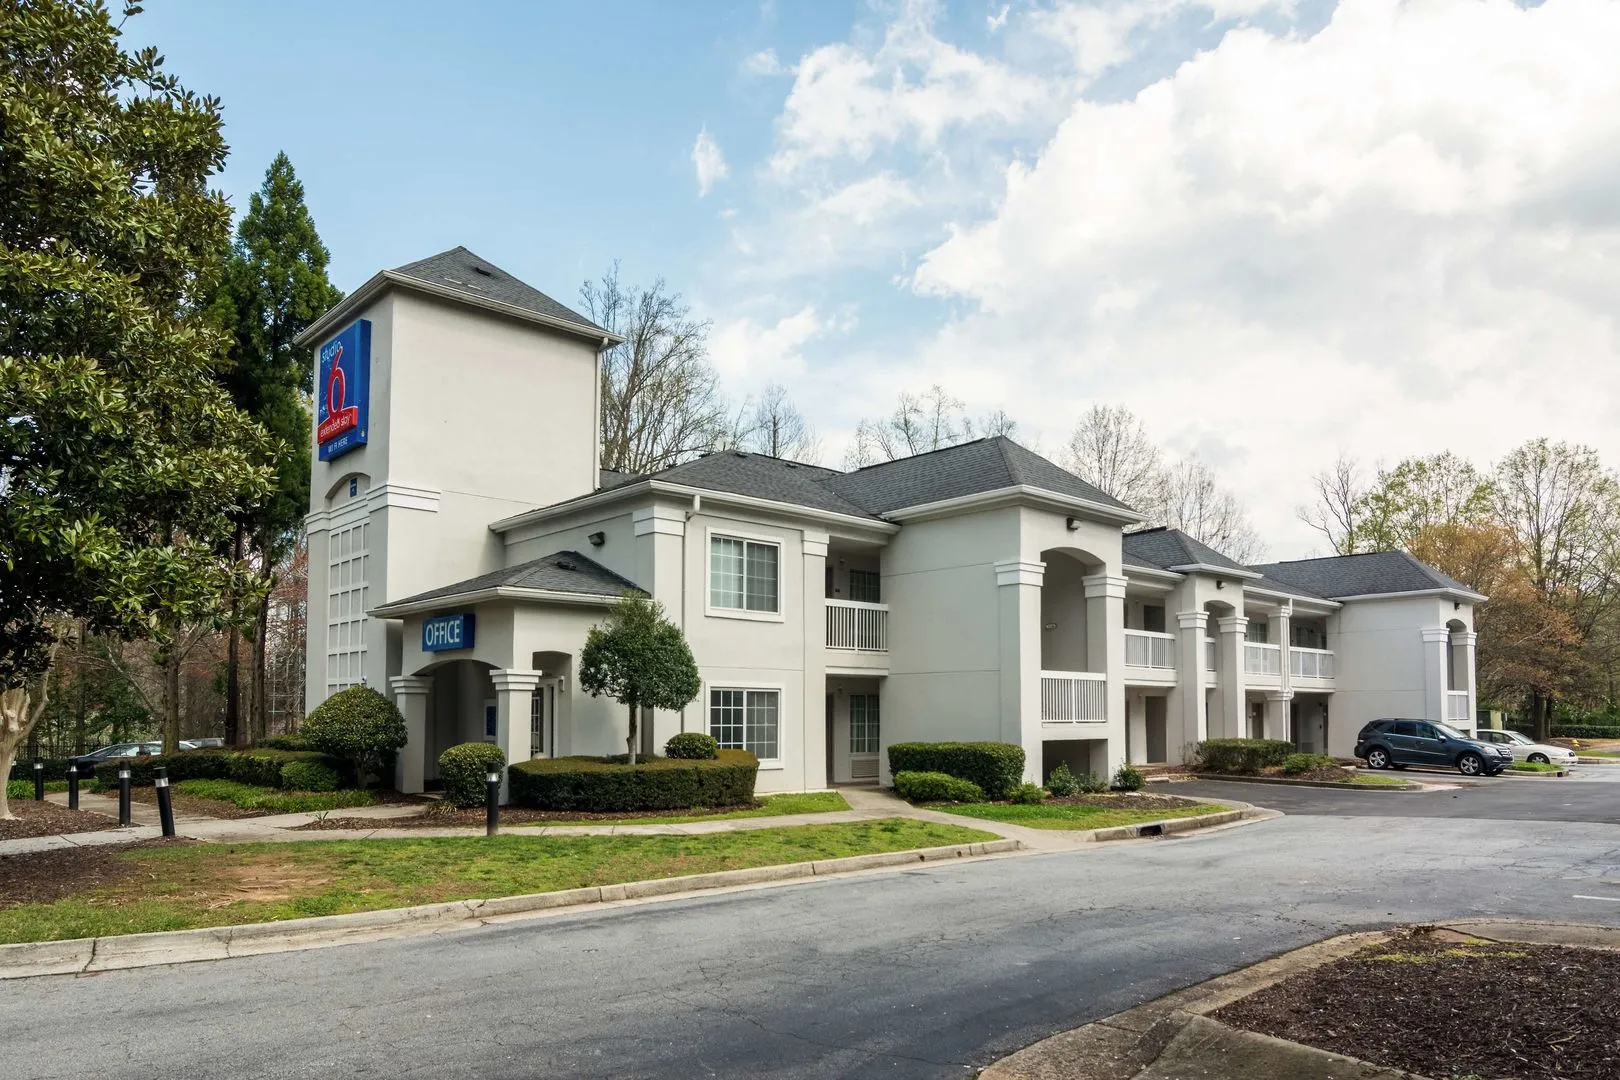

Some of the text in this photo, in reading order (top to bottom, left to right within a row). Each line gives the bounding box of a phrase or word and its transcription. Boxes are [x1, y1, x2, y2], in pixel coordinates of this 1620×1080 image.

[321, 340, 342, 362] studio
[327, 346, 345, 417] 6
[320, 418, 340, 437] extended
[338, 436, 348, 449] HERE
[425, 621, 460, 646] OFFICE
